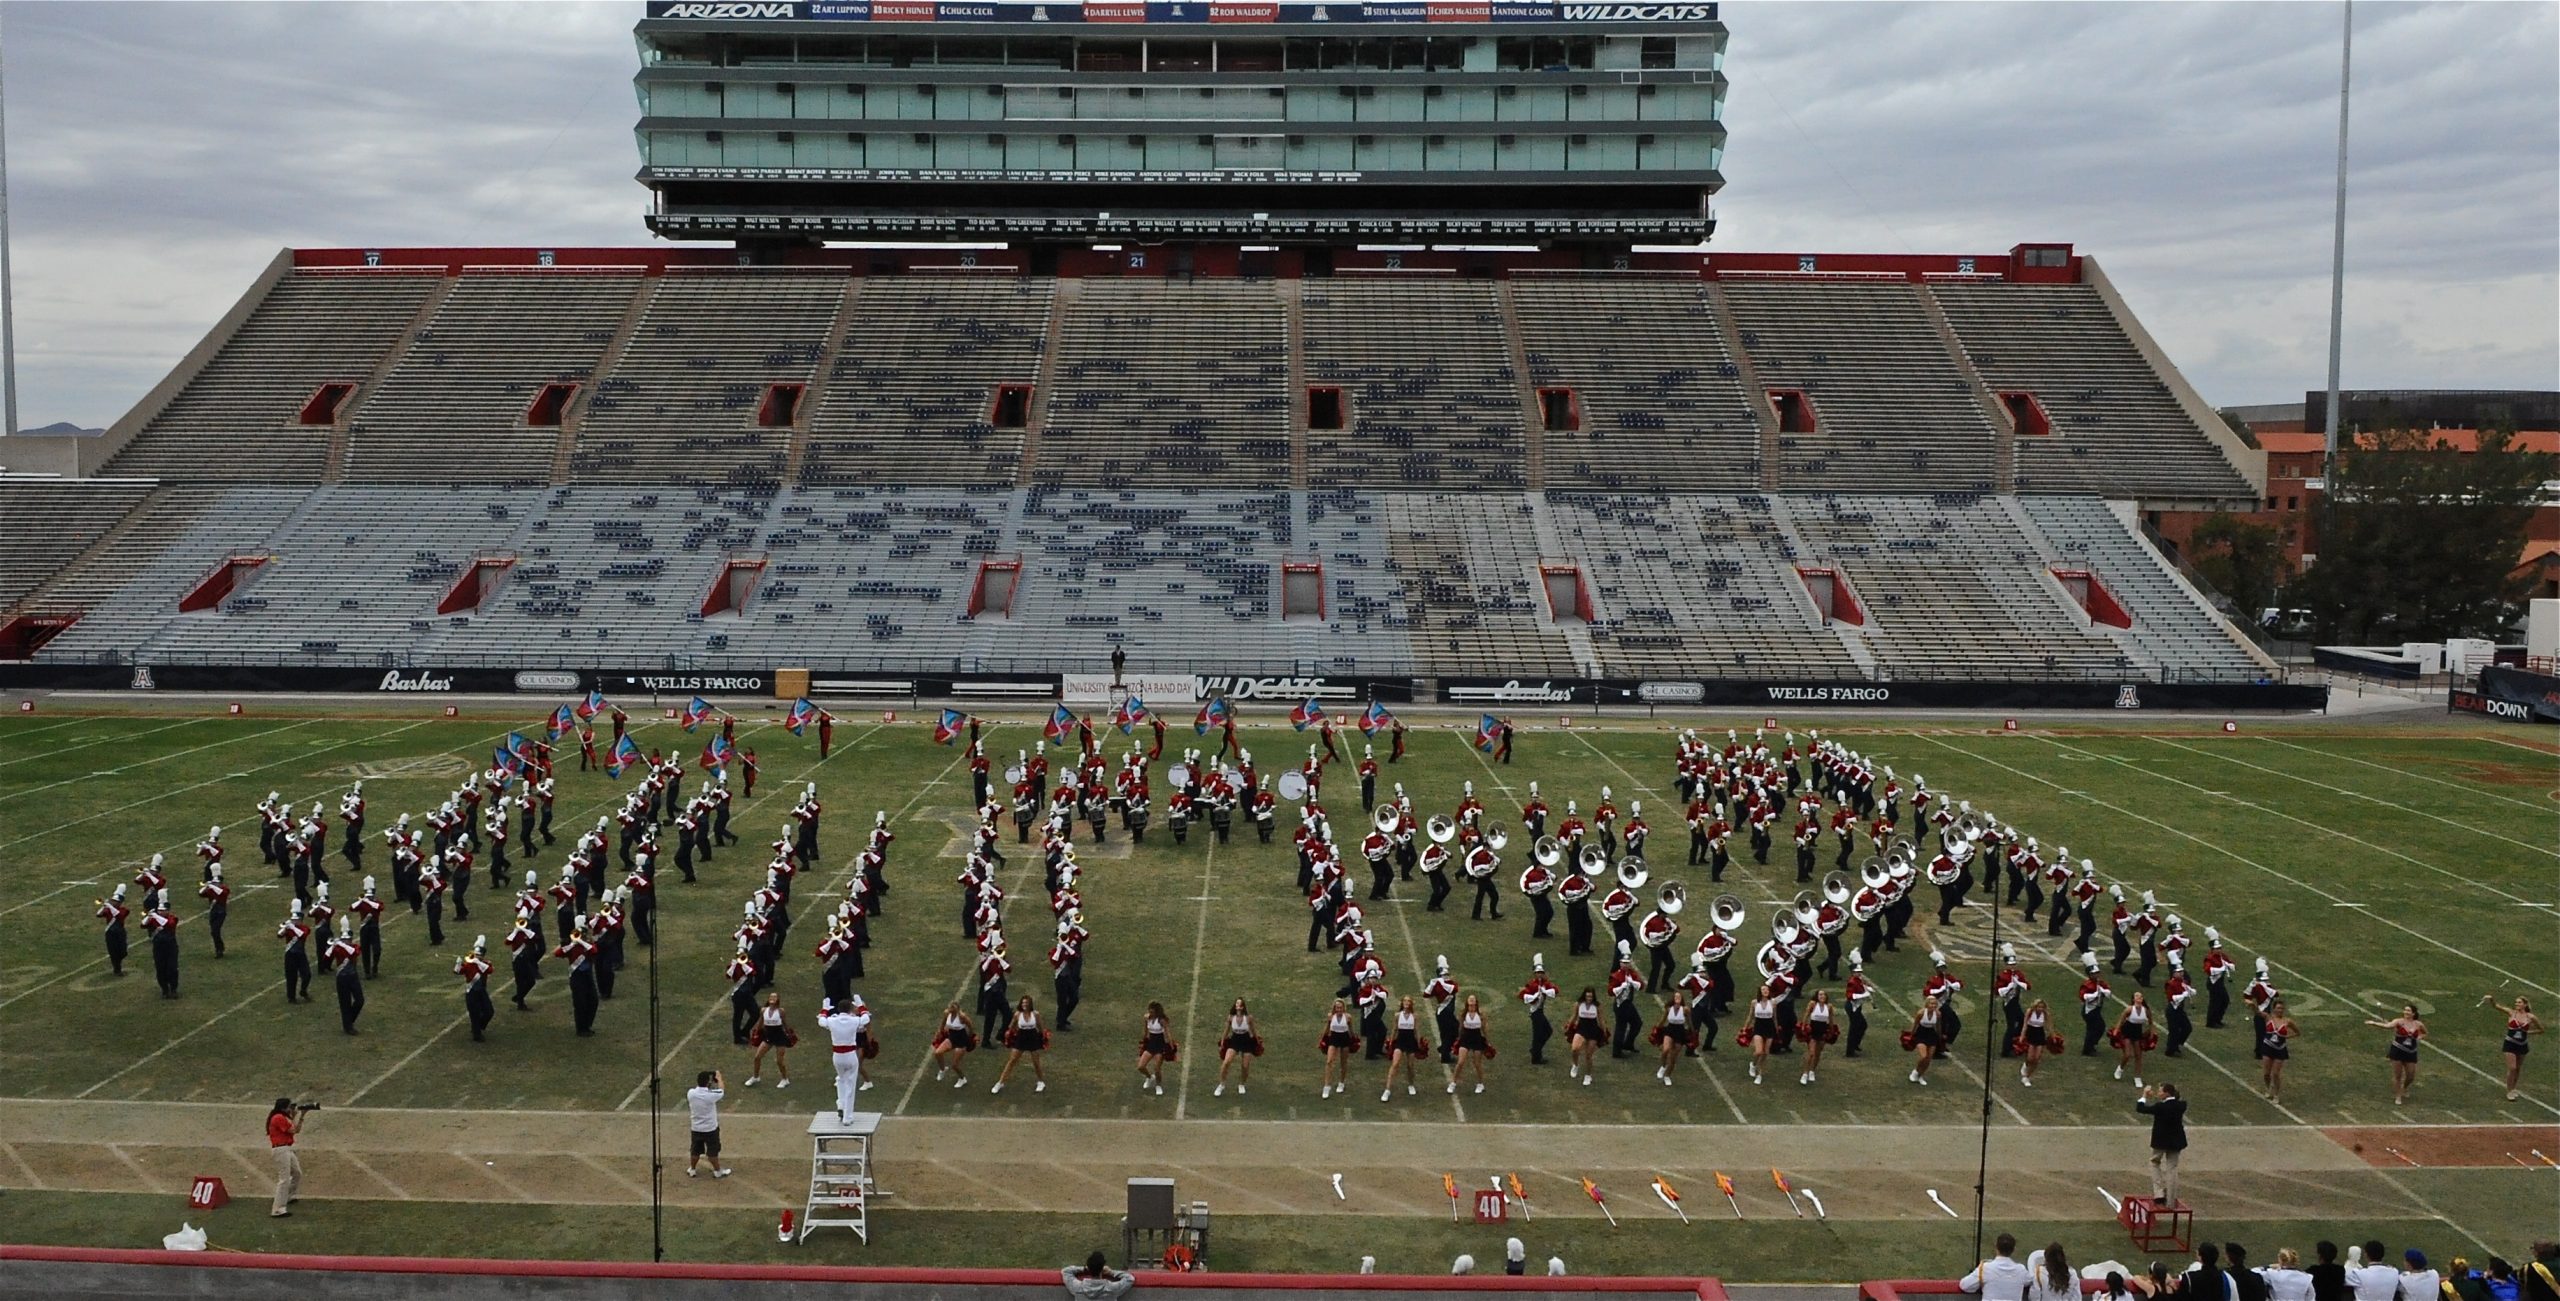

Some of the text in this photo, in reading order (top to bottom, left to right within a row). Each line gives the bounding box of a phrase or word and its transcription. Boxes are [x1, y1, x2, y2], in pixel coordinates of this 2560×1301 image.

[661, 3, 795, 18] ARIZONA
[812, 5, 868, 14] 22 ART LUPPINO
[883, 6, 904, 15] RICKY
[905, 6, 934, 15] HUNLEY
[940, 7, 993, 16] 6 CHUCK CECIL
[1083, 7, 1145, 16] 4 DARRYLL LEWIS
[1219, 7, 1235, 16] ROB
[1236, 7, 1271, 16] WALDROP
[1497, 7, 1527, 16] ANTOINE
[1528, 7, 1553, 16] CASON
[1563, 5, 1711, 20] WILDCATS
[366, 256, 379, 266] 17
[540, 255, 553, 266] 18
[960, 256, 976, 266] 20
[1130, 257, 1144, 268] 21
[1386, 258, 1401, 269] 22
[1800, 261, 1814, 271] 24
[1959, 263, 1974, 273] 25
[378, 669, 454, 691] Bashas'
[539, 676, 574, 684] CASINOS
[641, 677, 761, 690] WELLS FARGO
[1066, 681, 1107, 694] UNIVERSITY
[1154, 683, 1176, 694] BAND
[1176, 683, 1192, 694] DAY
[1662, 687, 1700, 695] CASINOS
[1768, 687, 1889, 700] WELLS FARGO
[2486, 700, 2528, 719] DOWN
[192, 1181, 214, 1205] 40
[1479, 1195, 1501, 1218] 40
